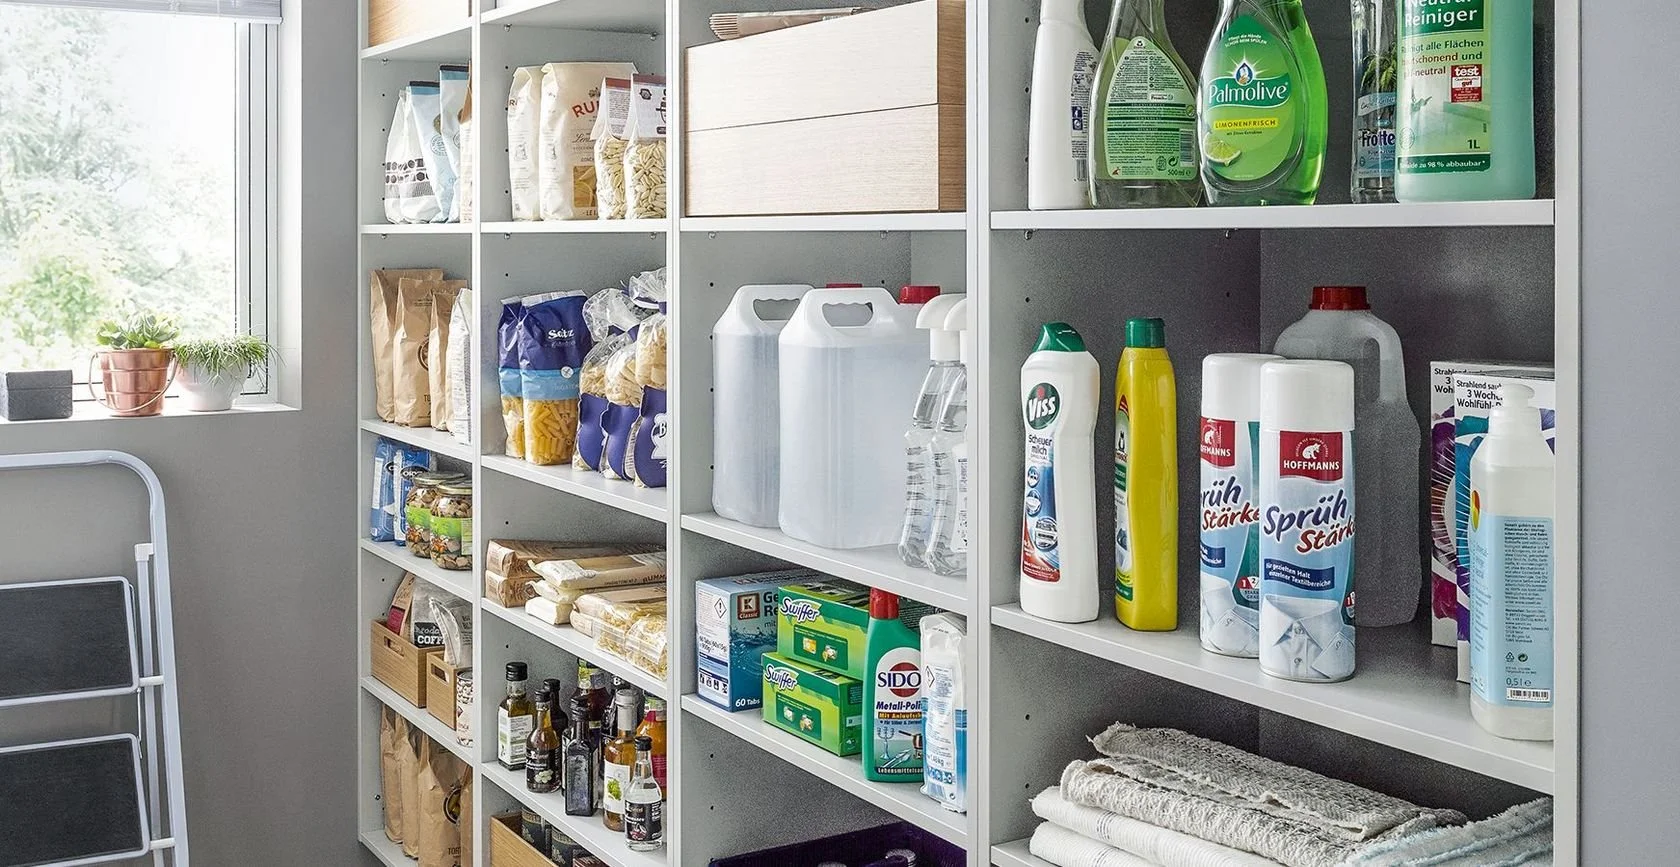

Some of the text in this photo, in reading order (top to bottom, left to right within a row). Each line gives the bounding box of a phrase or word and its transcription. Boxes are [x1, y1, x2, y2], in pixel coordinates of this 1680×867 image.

[1405, 8, 1477, 28] Reiniger
[1426, 41, 1442, 51] alle
[1444, 39, 1484, 49] Flächen
[1462, 52, 1483, 61] und
[1455, 66, 1480, 77] test
[1208, 81, 1287, 104] Palmolive
[572, 101, 600, 118] RU
[1215, 119, 1276, 129] LIMONENFRISCH
[1467, 139, 1480, 149] 1L
[1456, 380, 1487, 389] Strahlend
[1467, 389, 1503, 401] 3 Woch
[1283, 460, 1340, 471] HOFFMANNS
[1200, 476, 1241, 508] rüh
[1264, 489, 1348, 542] Sprüh
[781, 597, 819, 620] Swiffer
[765, 665, 797, 689] Swiffer
[877, 671, 922, 688] SIDO
[735, 698, 760, 708] 60 Tabs
